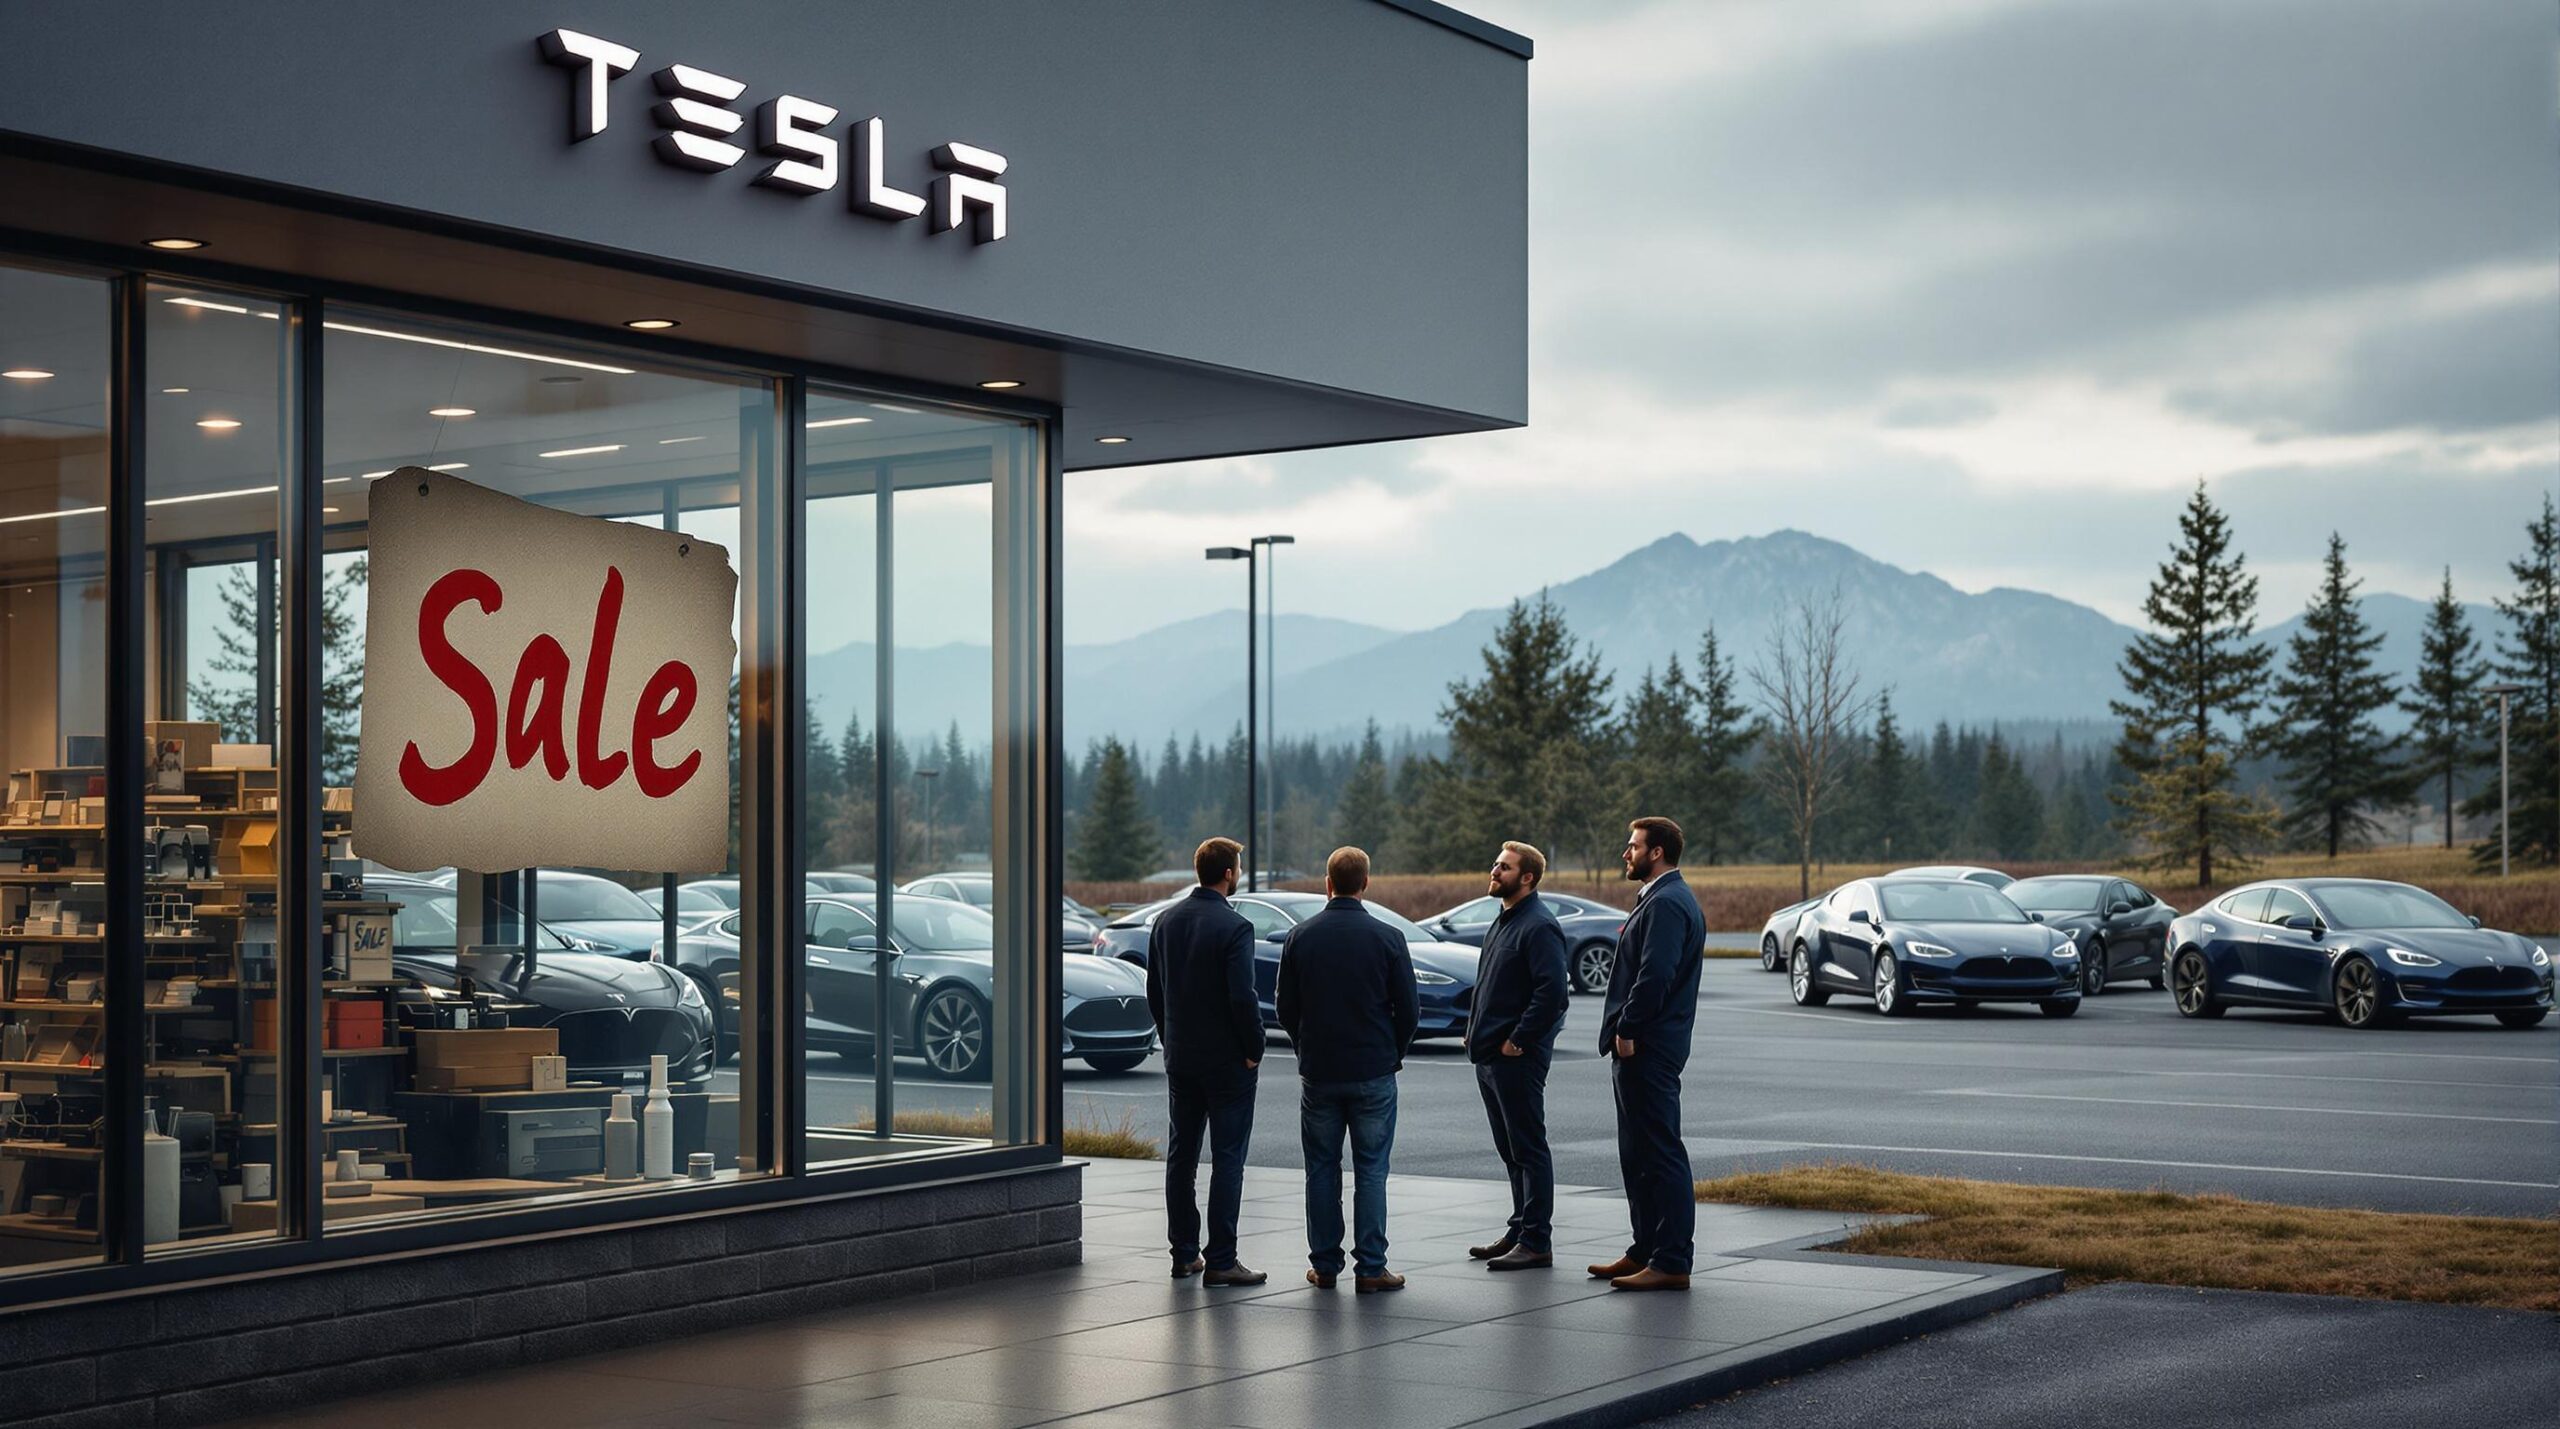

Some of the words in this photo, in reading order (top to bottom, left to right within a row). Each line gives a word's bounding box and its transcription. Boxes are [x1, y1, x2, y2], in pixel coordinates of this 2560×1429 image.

[538, 28, 1009, 243] TESLA
[399, 566, 701, 806] Sale
[354, 921, 388, 951] SALE
